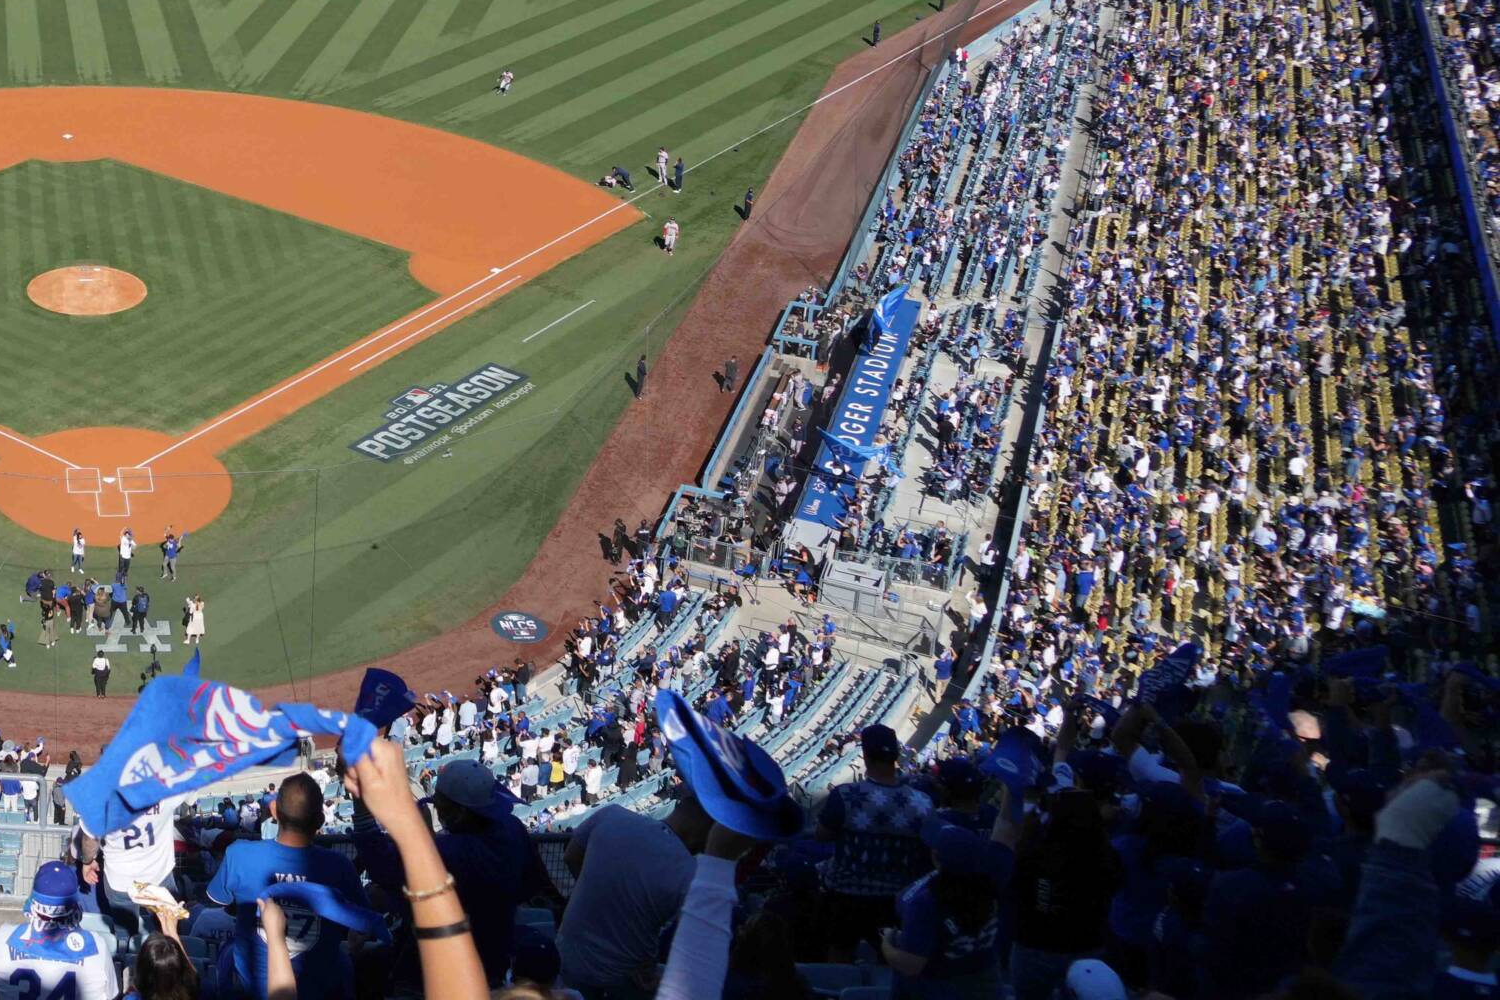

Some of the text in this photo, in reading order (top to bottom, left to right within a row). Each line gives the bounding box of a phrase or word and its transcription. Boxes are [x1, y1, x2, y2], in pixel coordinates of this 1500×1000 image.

[428, 383, 449, 395] 21
[356, 366, 521, 460] POSTSEASON
[499, 620, 537, 630] NLCS
[122, 822, 155, 850] 21
